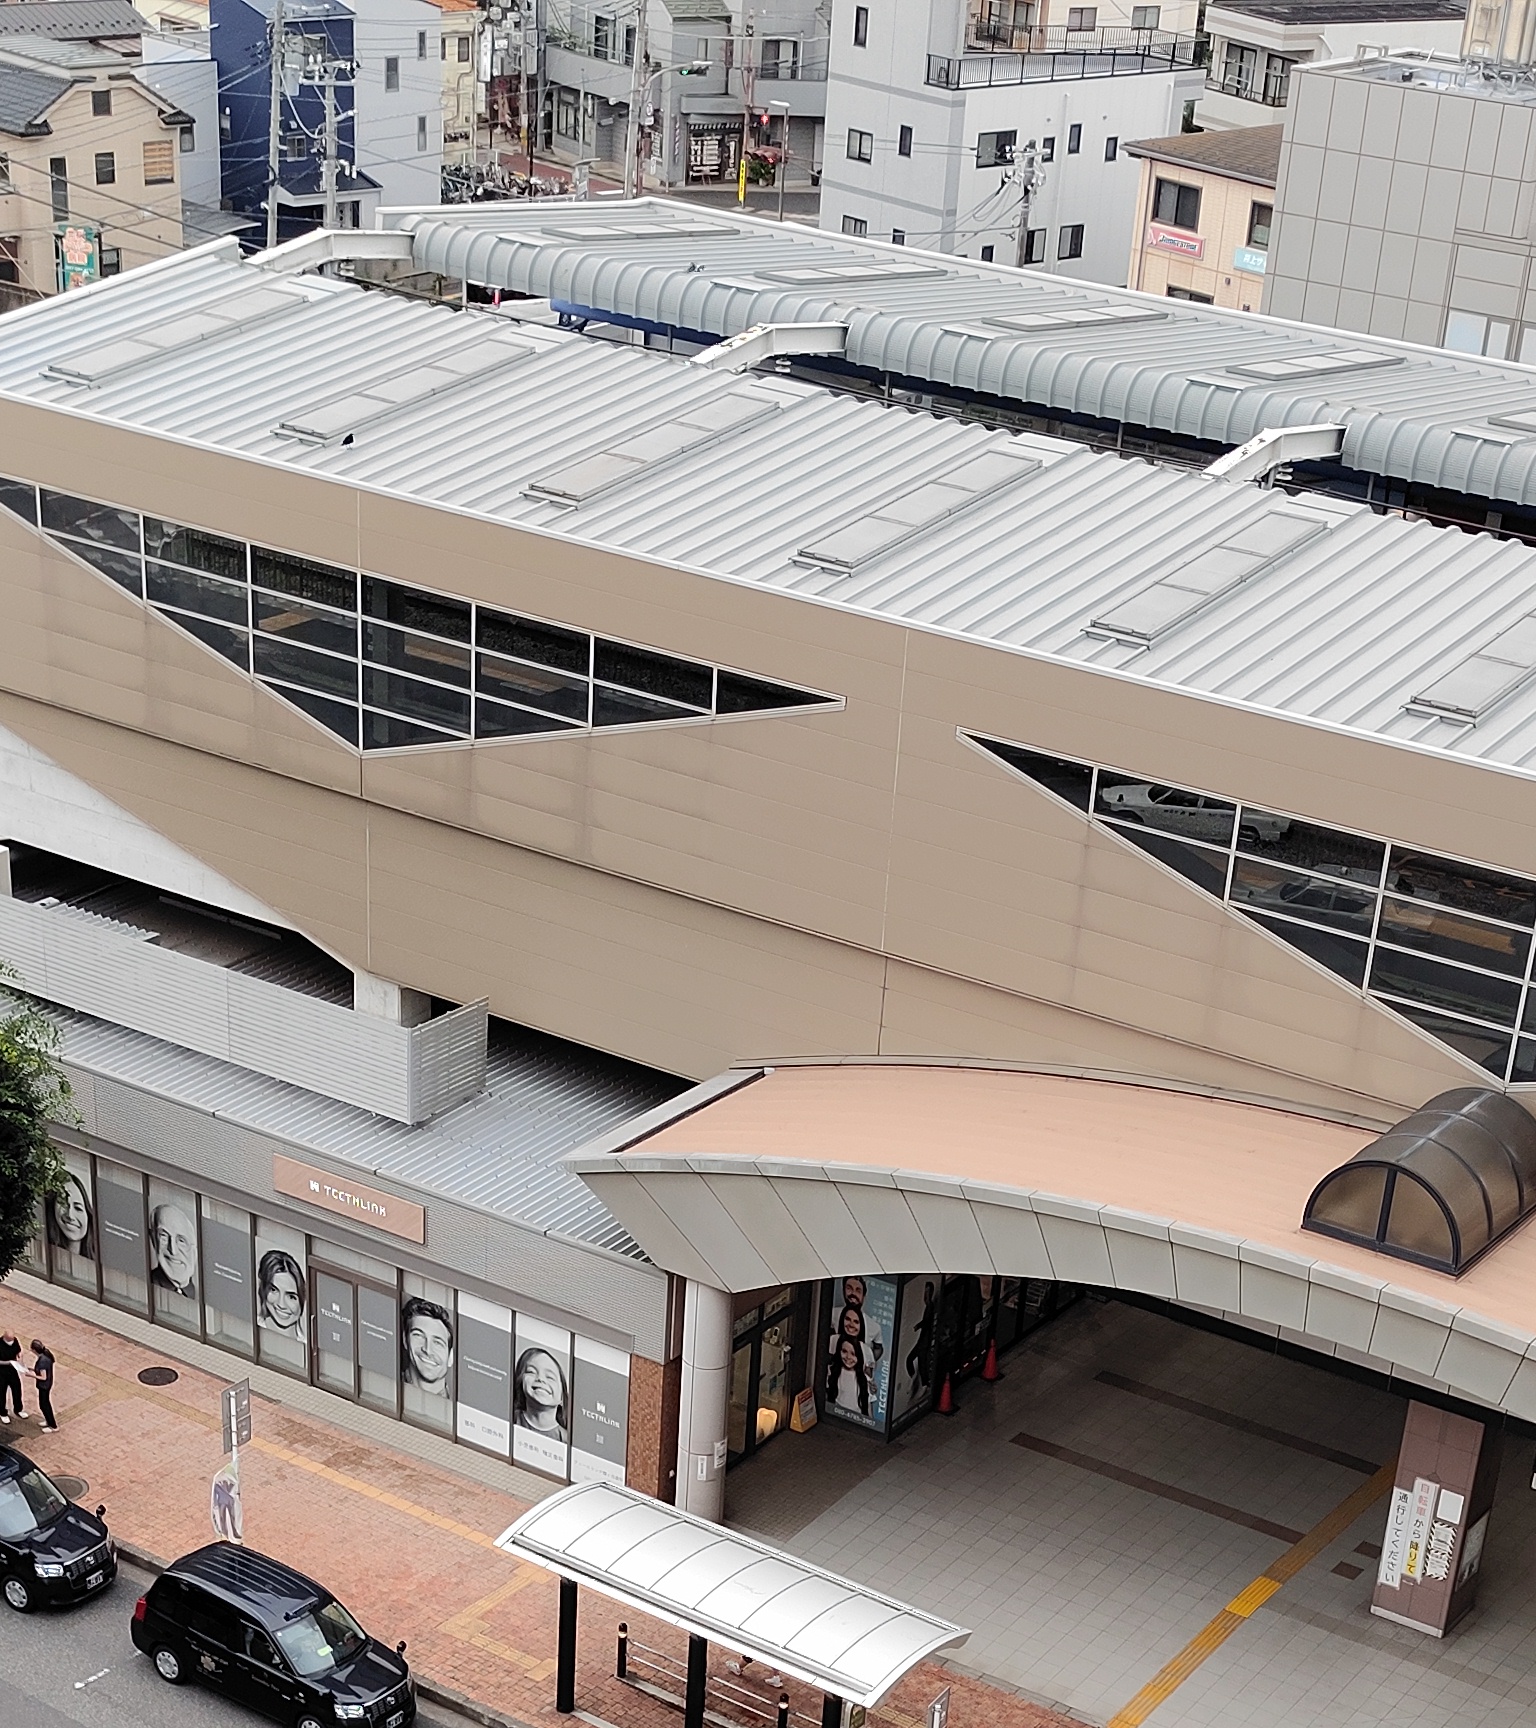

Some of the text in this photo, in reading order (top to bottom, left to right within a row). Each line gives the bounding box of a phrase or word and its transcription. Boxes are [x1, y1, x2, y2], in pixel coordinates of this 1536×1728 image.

[1385, 1491, 1409, 1582] 通行してください
